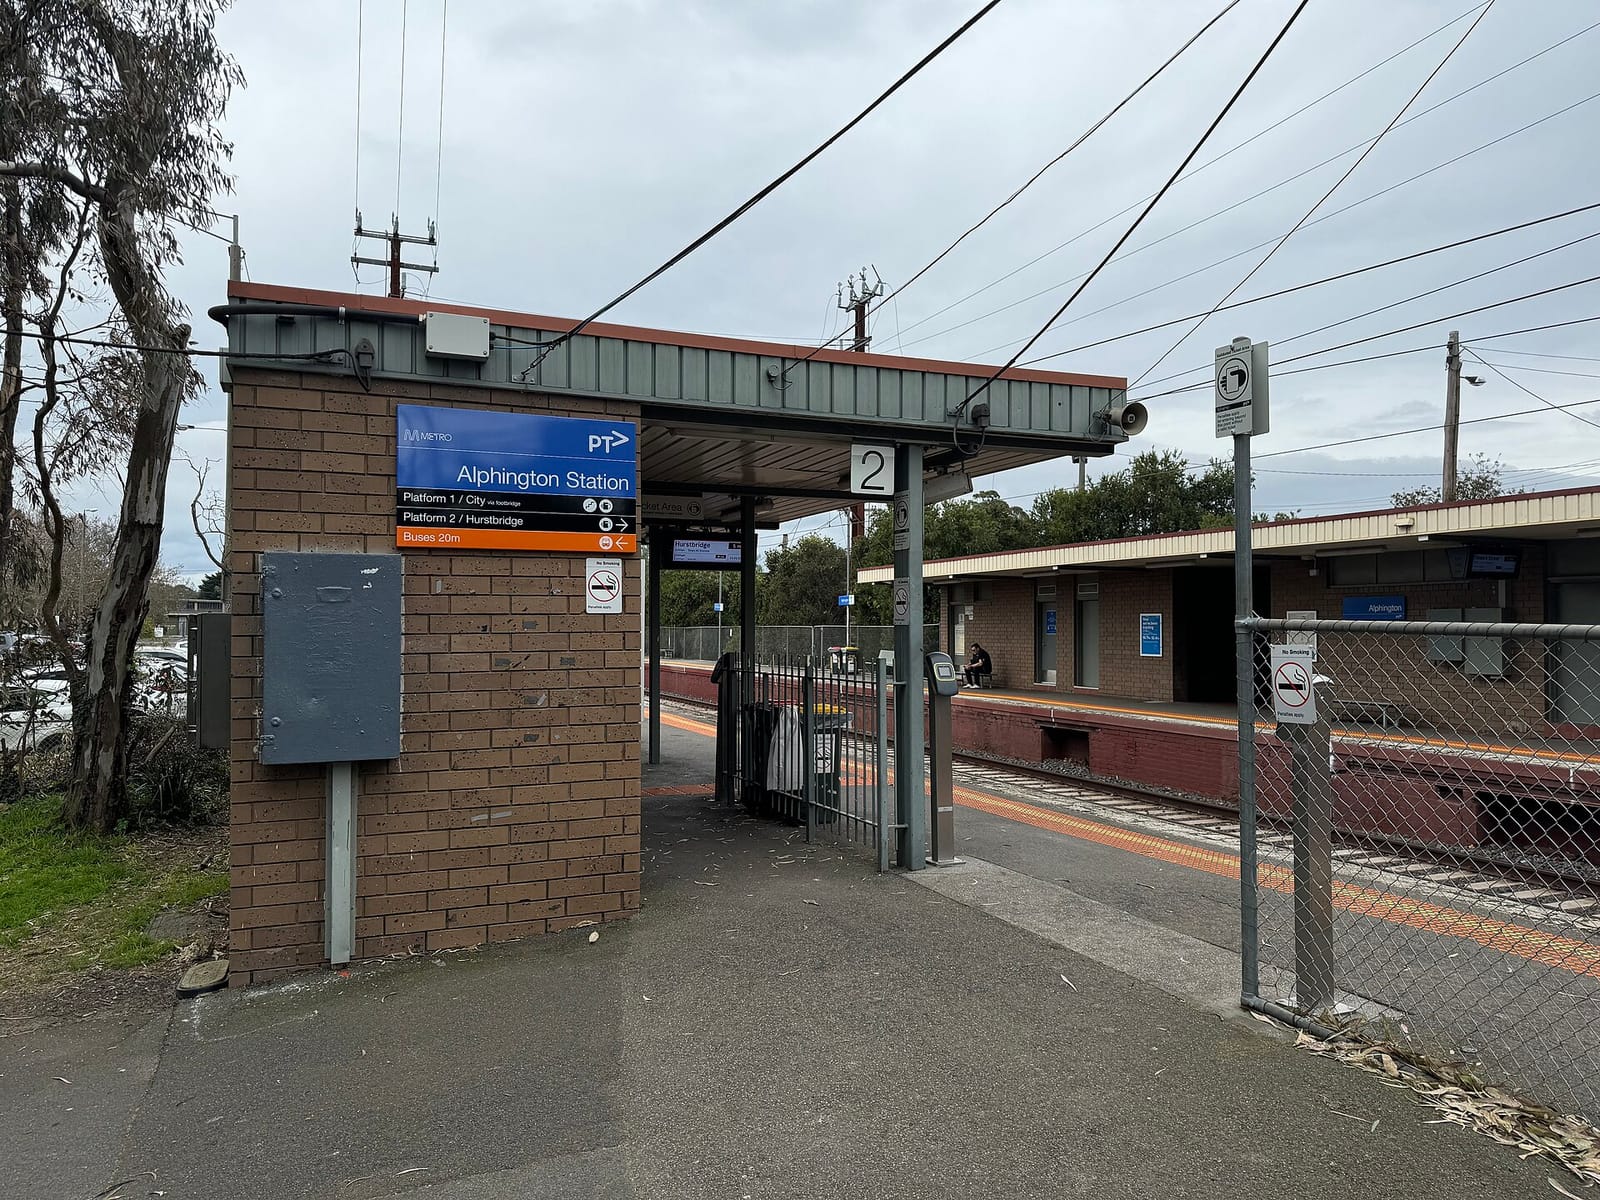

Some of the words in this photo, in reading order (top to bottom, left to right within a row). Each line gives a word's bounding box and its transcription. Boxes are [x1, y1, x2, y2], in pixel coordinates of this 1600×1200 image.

[420, 432, 452, 442] METRO
[860, 450, 885, 490] 2
[456, 465, 559, 490] Alphington
[566, 471, 629, 491] Station
[403, 492, 446, 503] Platform
[450, 494, 455, 503] 1
[458, 494, 464, 504] /
[466, 494, 486, 507] City
[496, 500, 521, 508] footbridge
[662, 502, 682, 512] Area
[403, 511, 446, 523] Platform
[449, 513, 456, 523] 2
[458, 513, 464, 523] /
[466, 514, 524, 528] Hurstbridge
[403, 531, 436, 542] Buses
[438, 533, 461, 543] 20m
[674, 541, 711, 550] Hurstbridge
[1368, 604, 1403, 613] Alphington
